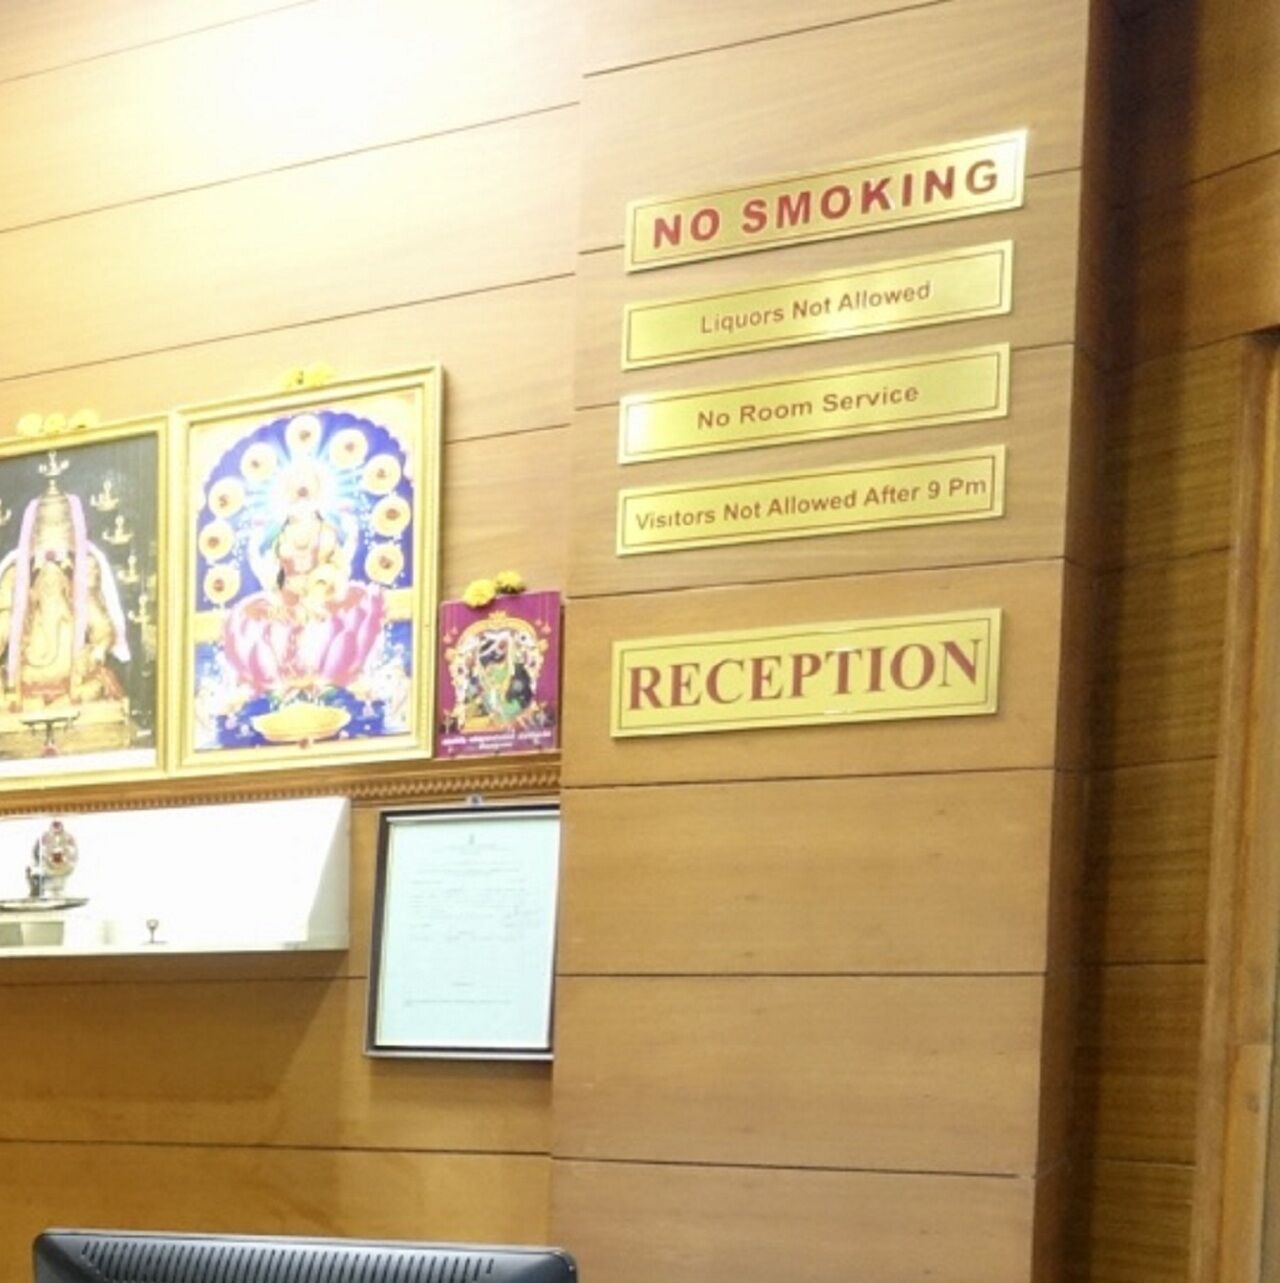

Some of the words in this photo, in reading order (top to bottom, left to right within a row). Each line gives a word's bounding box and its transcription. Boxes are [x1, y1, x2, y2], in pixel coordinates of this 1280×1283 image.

[653, 208, 721, 250] NO
[742, 159, 998, 234] SMOKING
[700, 308, 785, 335] Liquors
[792, 297, 832, 320] Not
[837, 281, 931, 311] Allowed
[697, 407, 731, 430] No
[739, 395, 813, 424] Room
[822, 383, 919, 412] Service
[636, 504, 716, 530] Visitors
[723, 499, 762, 520] Not
[767, 488, 857, 516] Allowed
[864, 482, 920, 505] After
[927, 479, 941, 500] 9
[948, 474, 986, 497] Pm
[627, 638, 982, 711] RECEPTION
